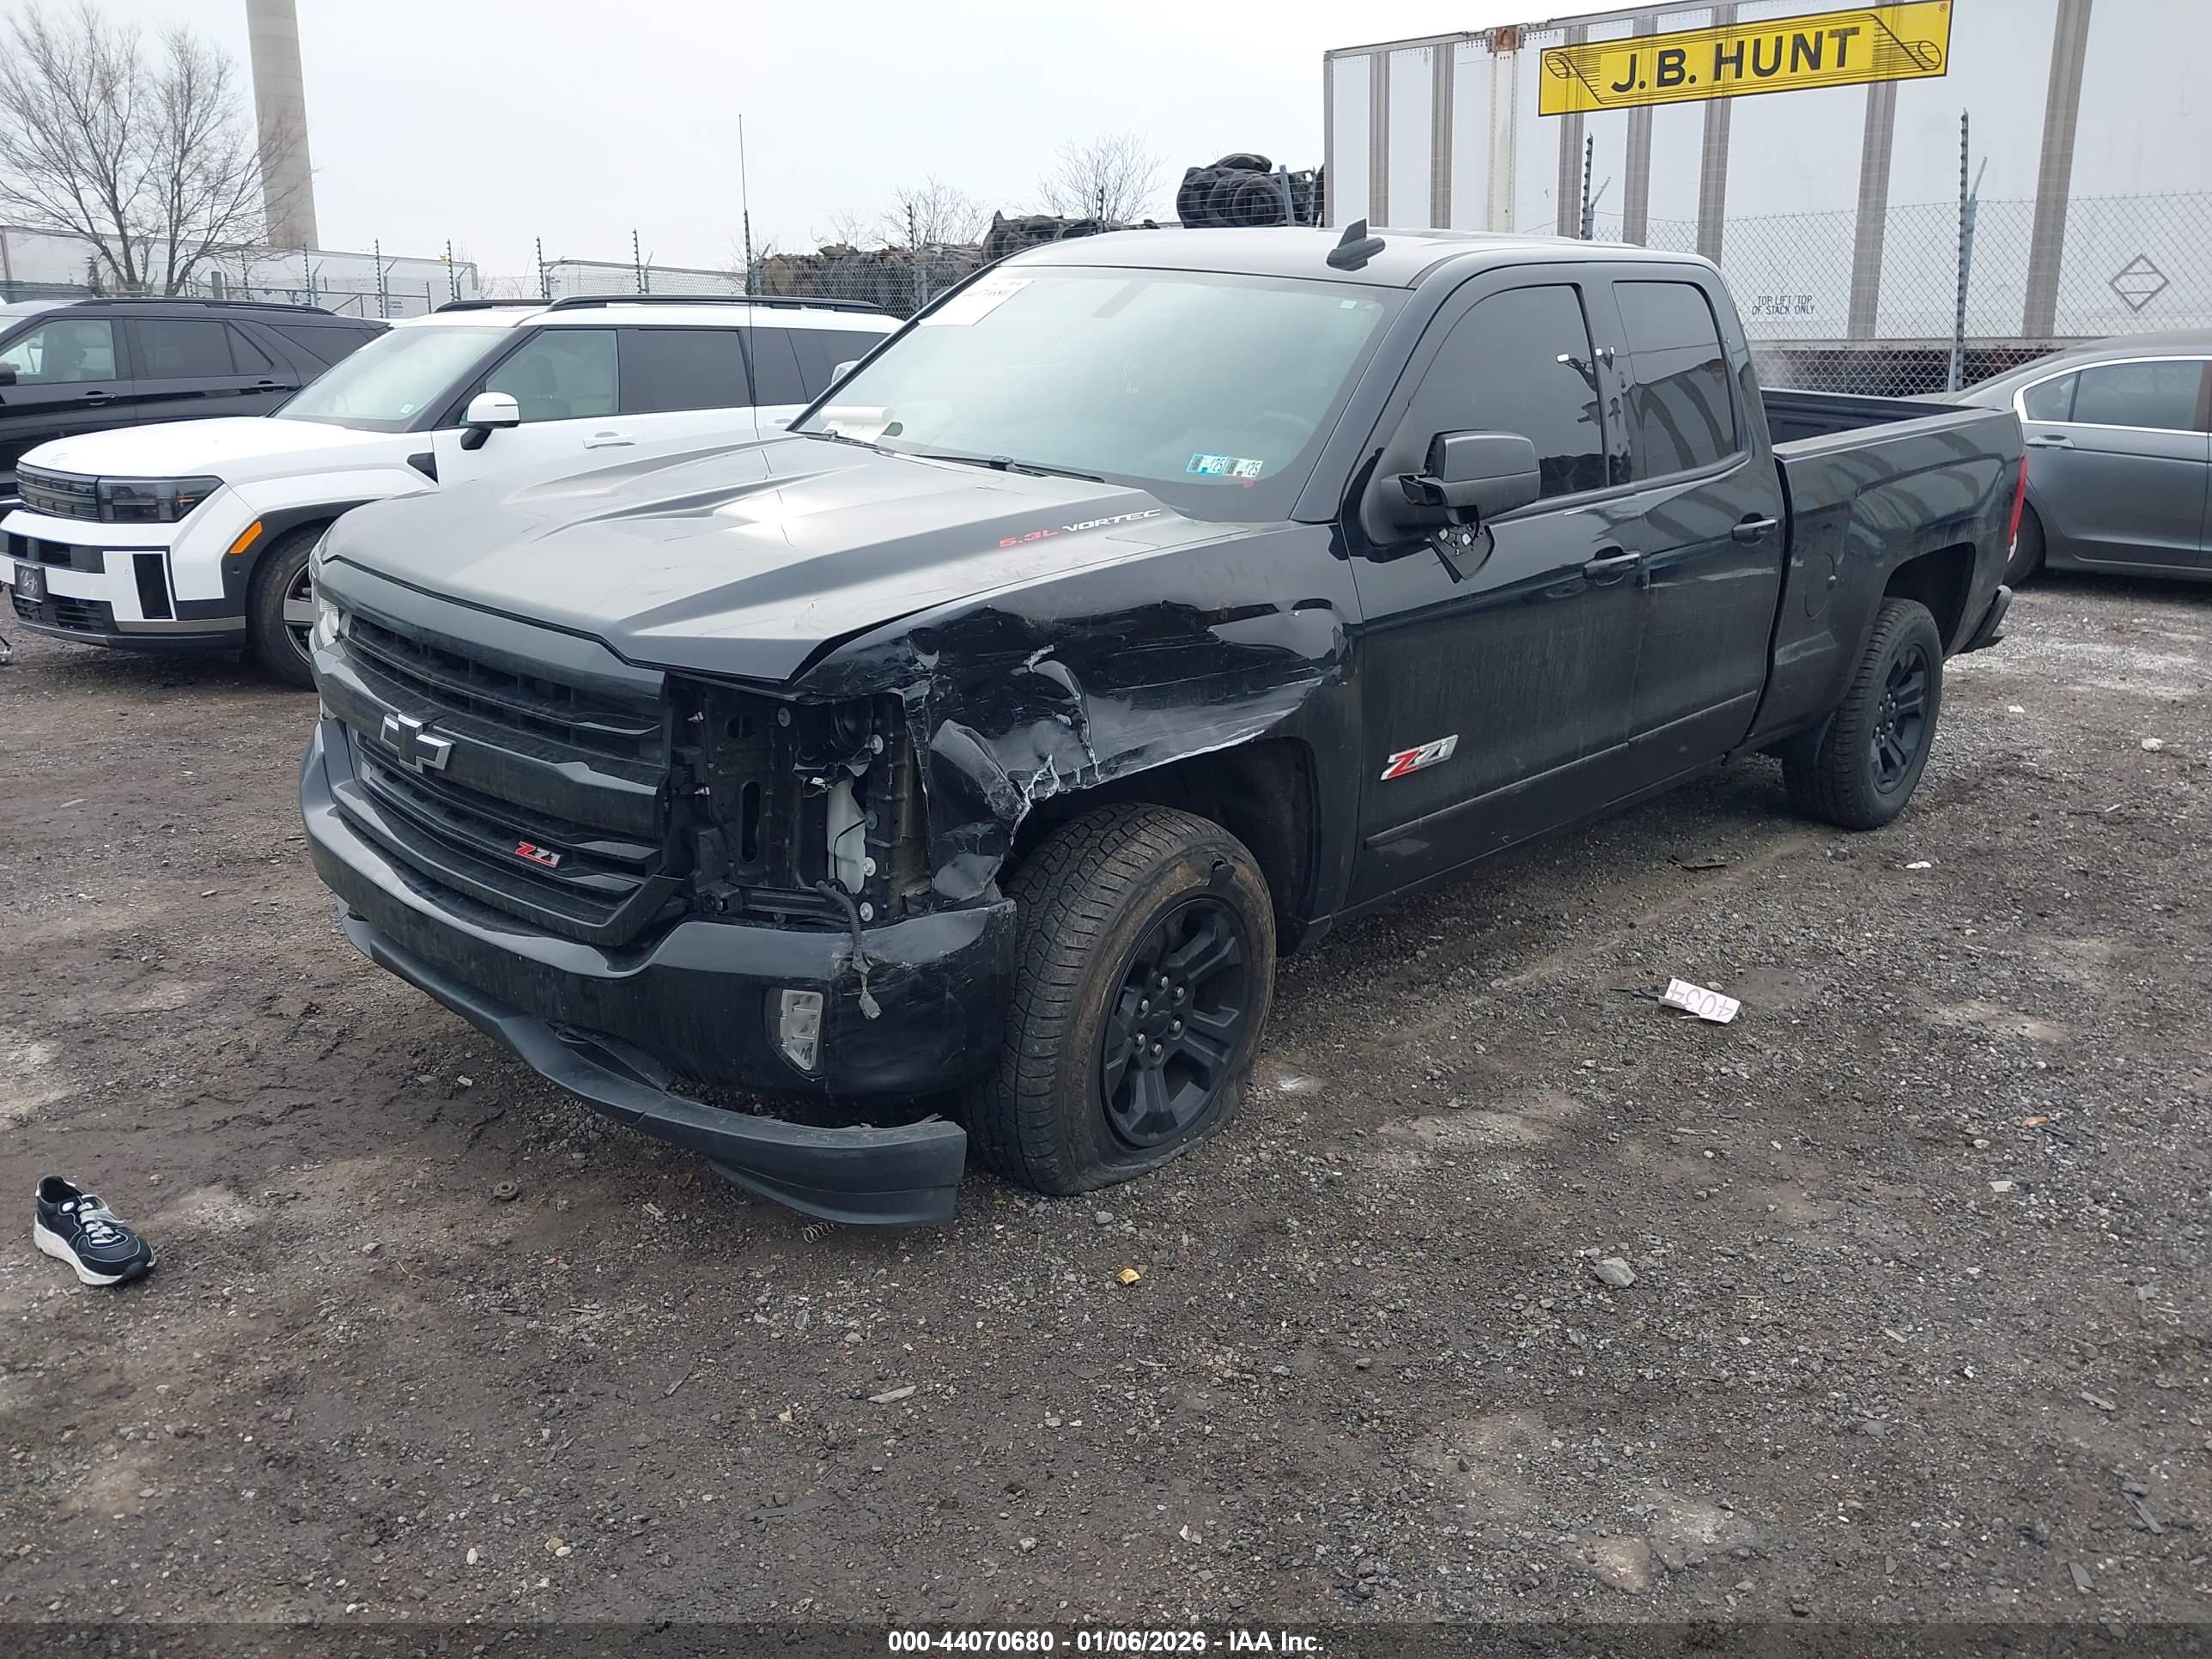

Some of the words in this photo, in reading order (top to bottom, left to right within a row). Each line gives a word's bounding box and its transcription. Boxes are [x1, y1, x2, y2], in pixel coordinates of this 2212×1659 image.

[1713, 27, 1860, 82] HUNT
[1752, 306, 1762, 315] OF
[1766, 306, 1790, 314] STACK
[1794, 305, 1815, 314] ONLY
[1757, 295, 1773, 306] TOP
[1775, 295, 1792, 305] LIFT
[1797, 295, 1813, 305] TOP
[998, 529, 1059, 549] 5.3L
[1061, 508, 1162, 532] VORTEC
[1380, 734, 1459, 781] Z71
[514, 841, 562, 868] Z71
[1668, 981, 1734, 1018] 4034
